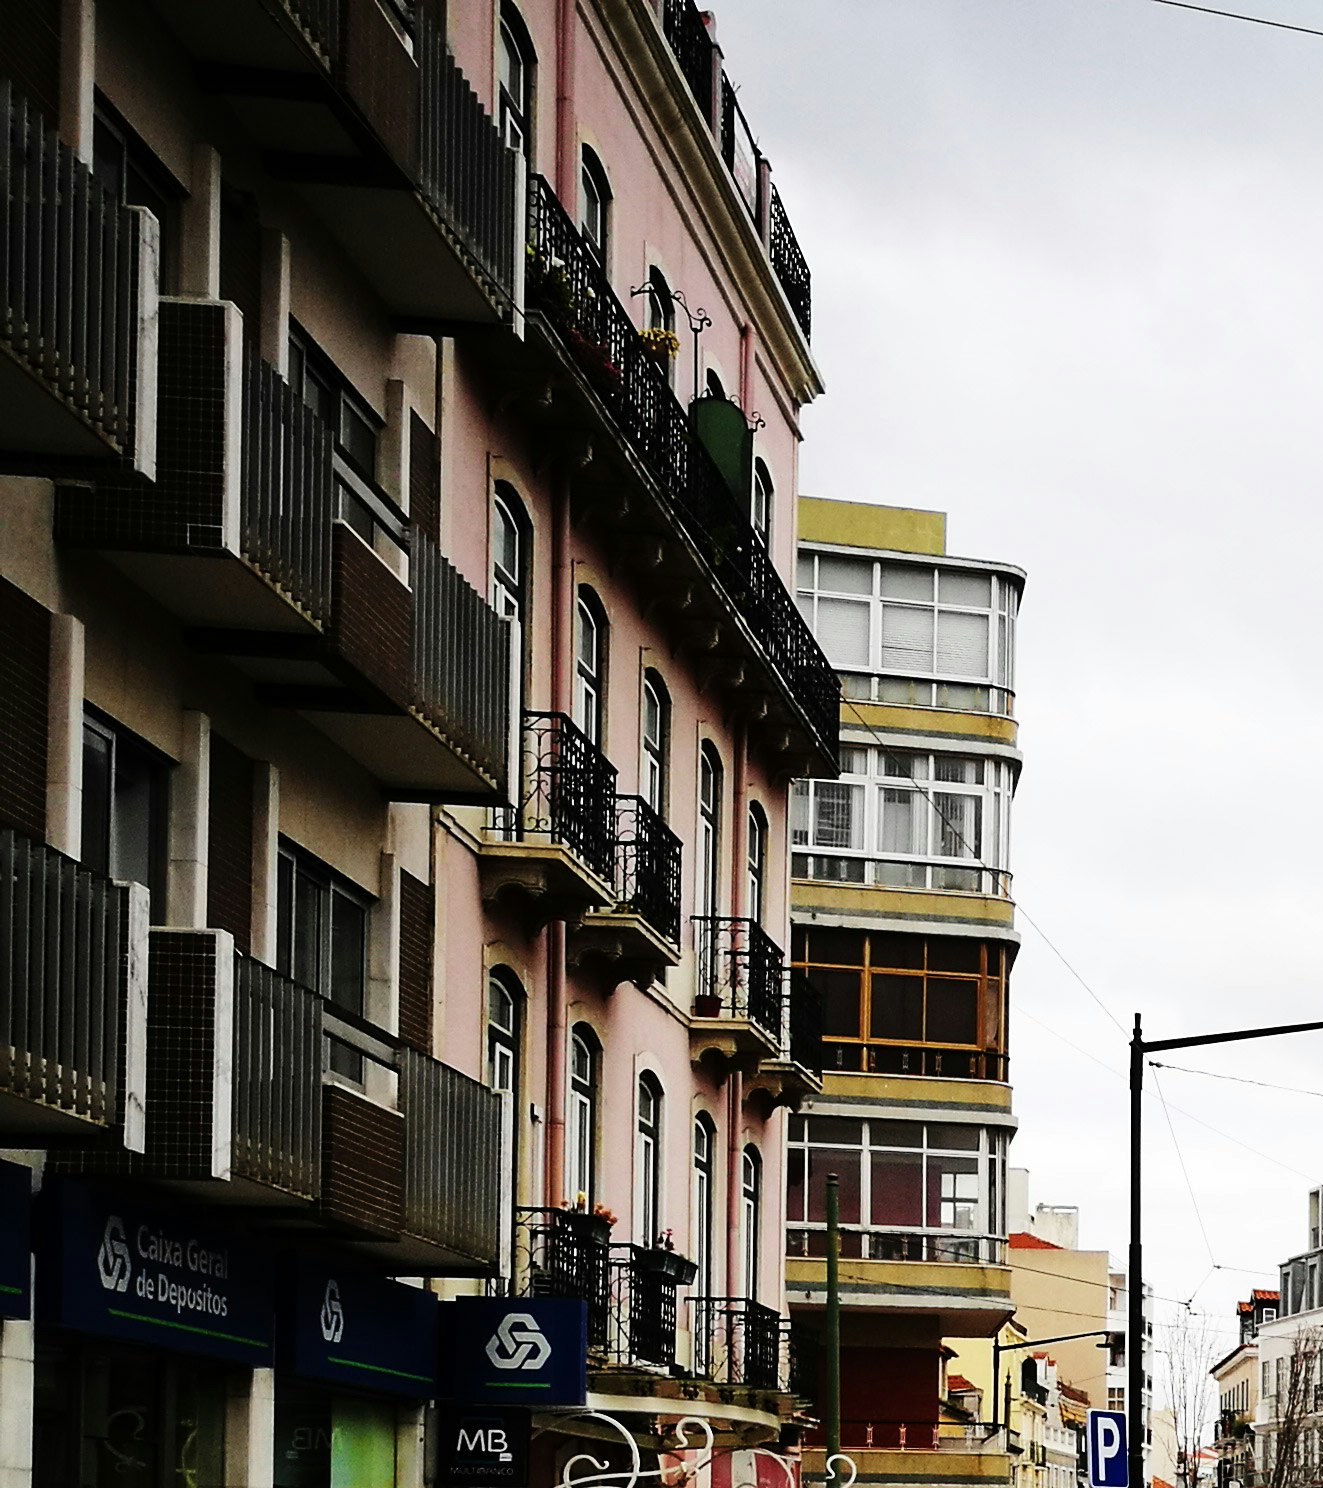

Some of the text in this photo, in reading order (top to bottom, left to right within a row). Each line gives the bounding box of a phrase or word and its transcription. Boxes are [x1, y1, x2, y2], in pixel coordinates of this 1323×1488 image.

[137, 1224, 228, 1280] Caixa Geral
[136, 1268, 154, 1300] de
[456, 1428, 509, 1452] MB
[1097, 1416, 1120, 1481] P
